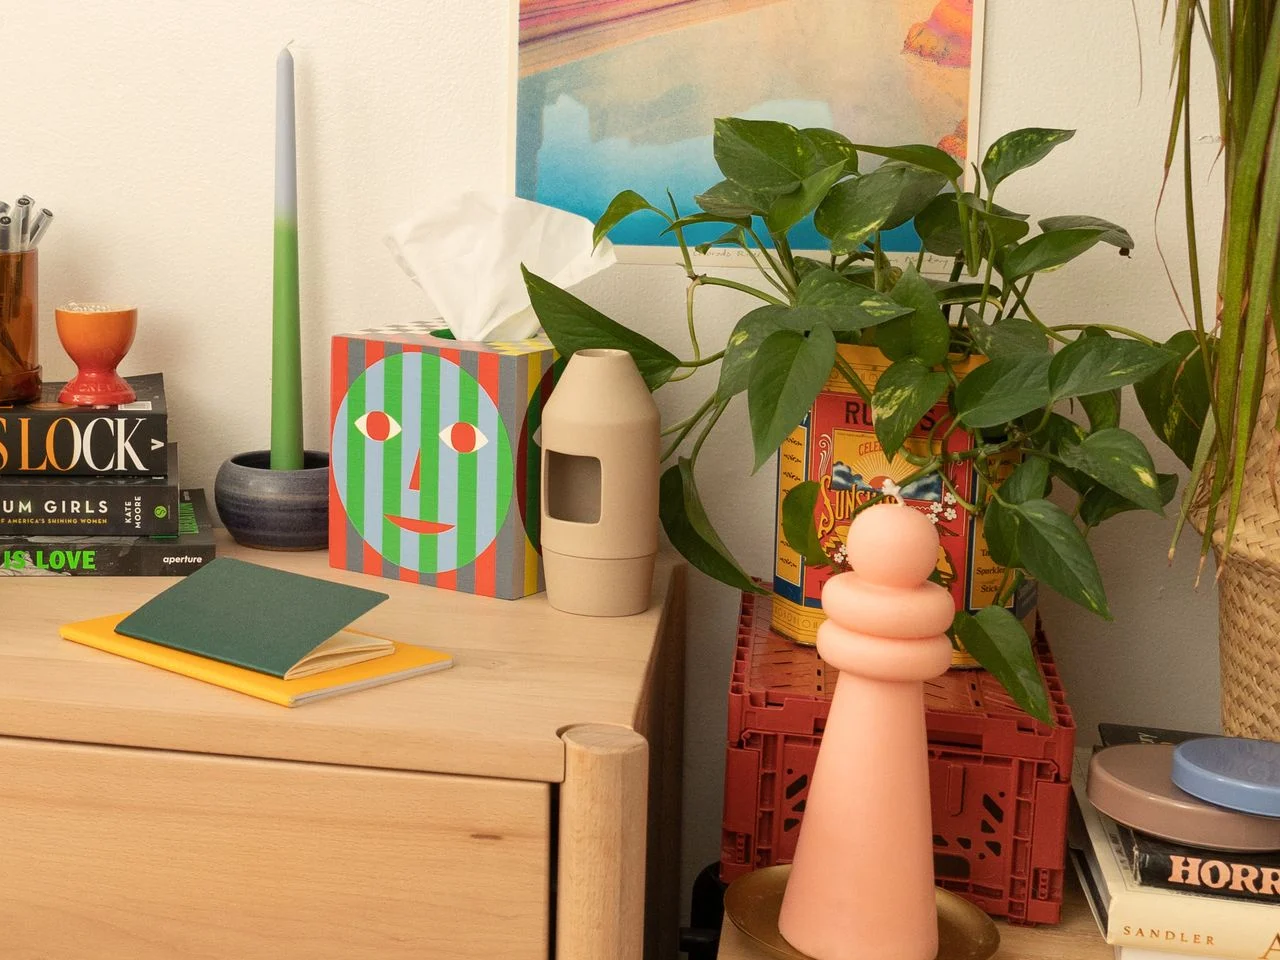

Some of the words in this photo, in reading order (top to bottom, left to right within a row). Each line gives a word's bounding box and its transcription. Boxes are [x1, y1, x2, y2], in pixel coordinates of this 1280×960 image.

[19, 416, 150, 472] LOCK
[44, 500, 109, 514] GIRLS
[124, 501, 132, 524] KATE
[134, 496, 142, 529] MOORE
[4, 550, 26, 570] IS
[37, 550, 97, 570] LOVE
[162, 555, 203, 565] aperture
[976, 564, 1006, 576] Sparkler
[1123, 924, 1215, 946] SANDLER
